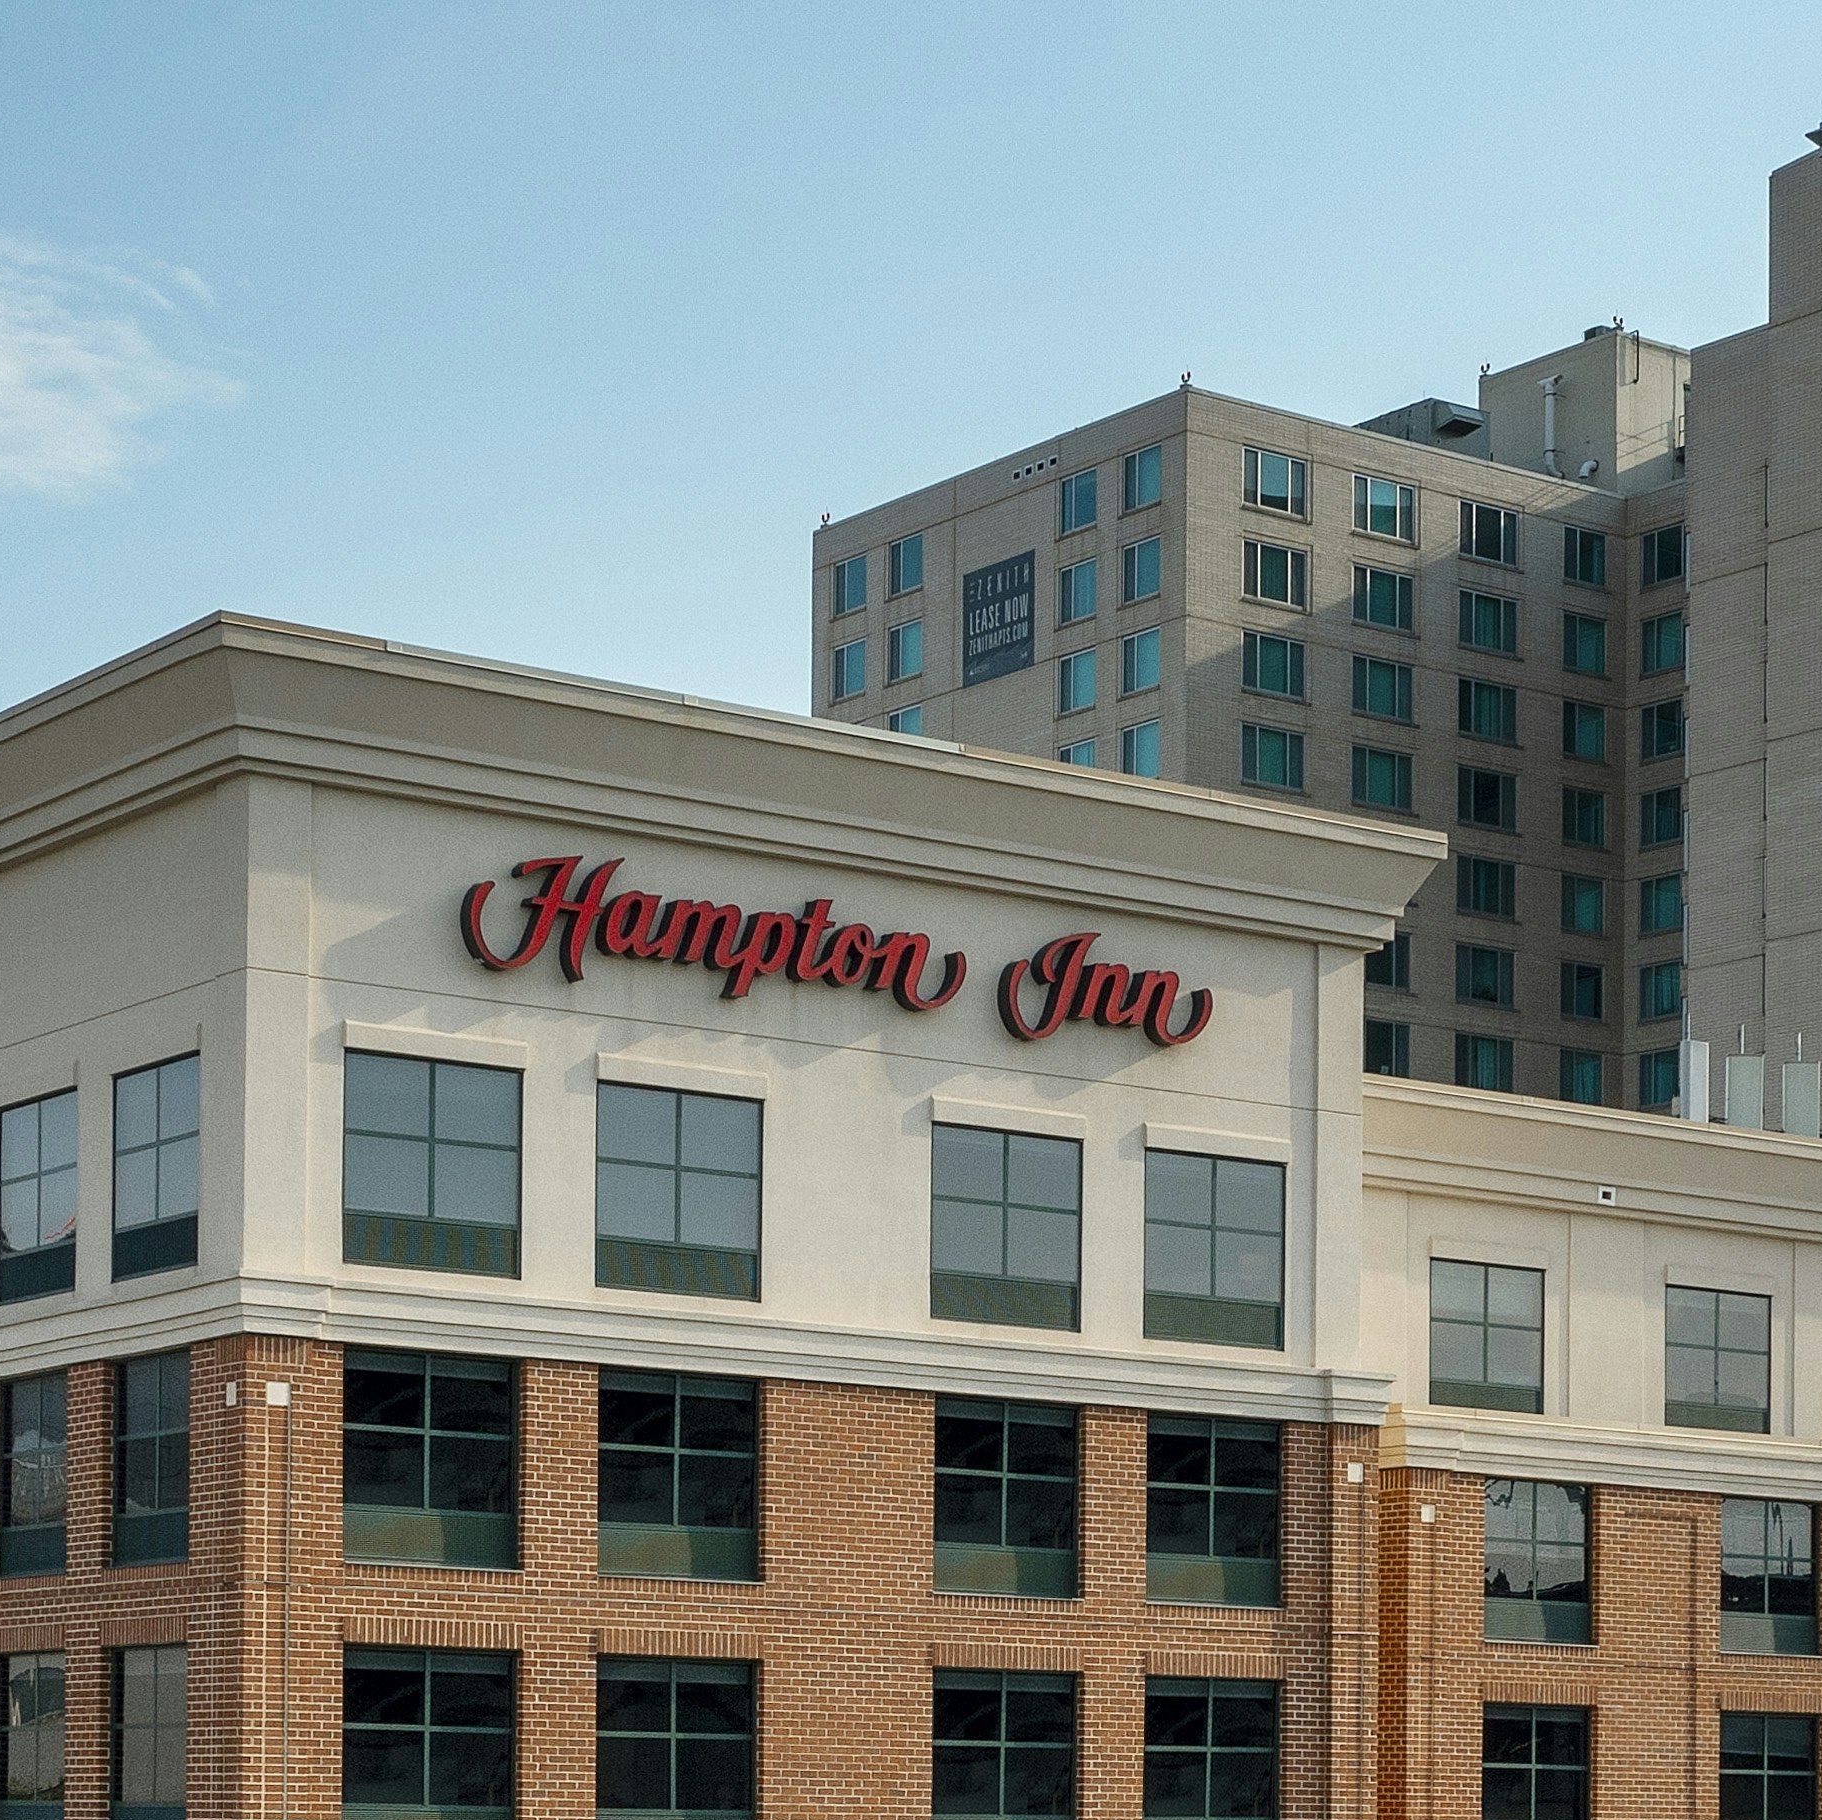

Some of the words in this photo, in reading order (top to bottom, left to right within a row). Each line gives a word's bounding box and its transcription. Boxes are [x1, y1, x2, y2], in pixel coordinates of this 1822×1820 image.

[977, 562, 1029, 600] ZENITH
[969, 603, 1001, 636] LEASE
[1004, 593, 1029, 623] NOW
[461, 854, 966, 1012] Hampton
[997, 932, 1213, 1047] Inn
